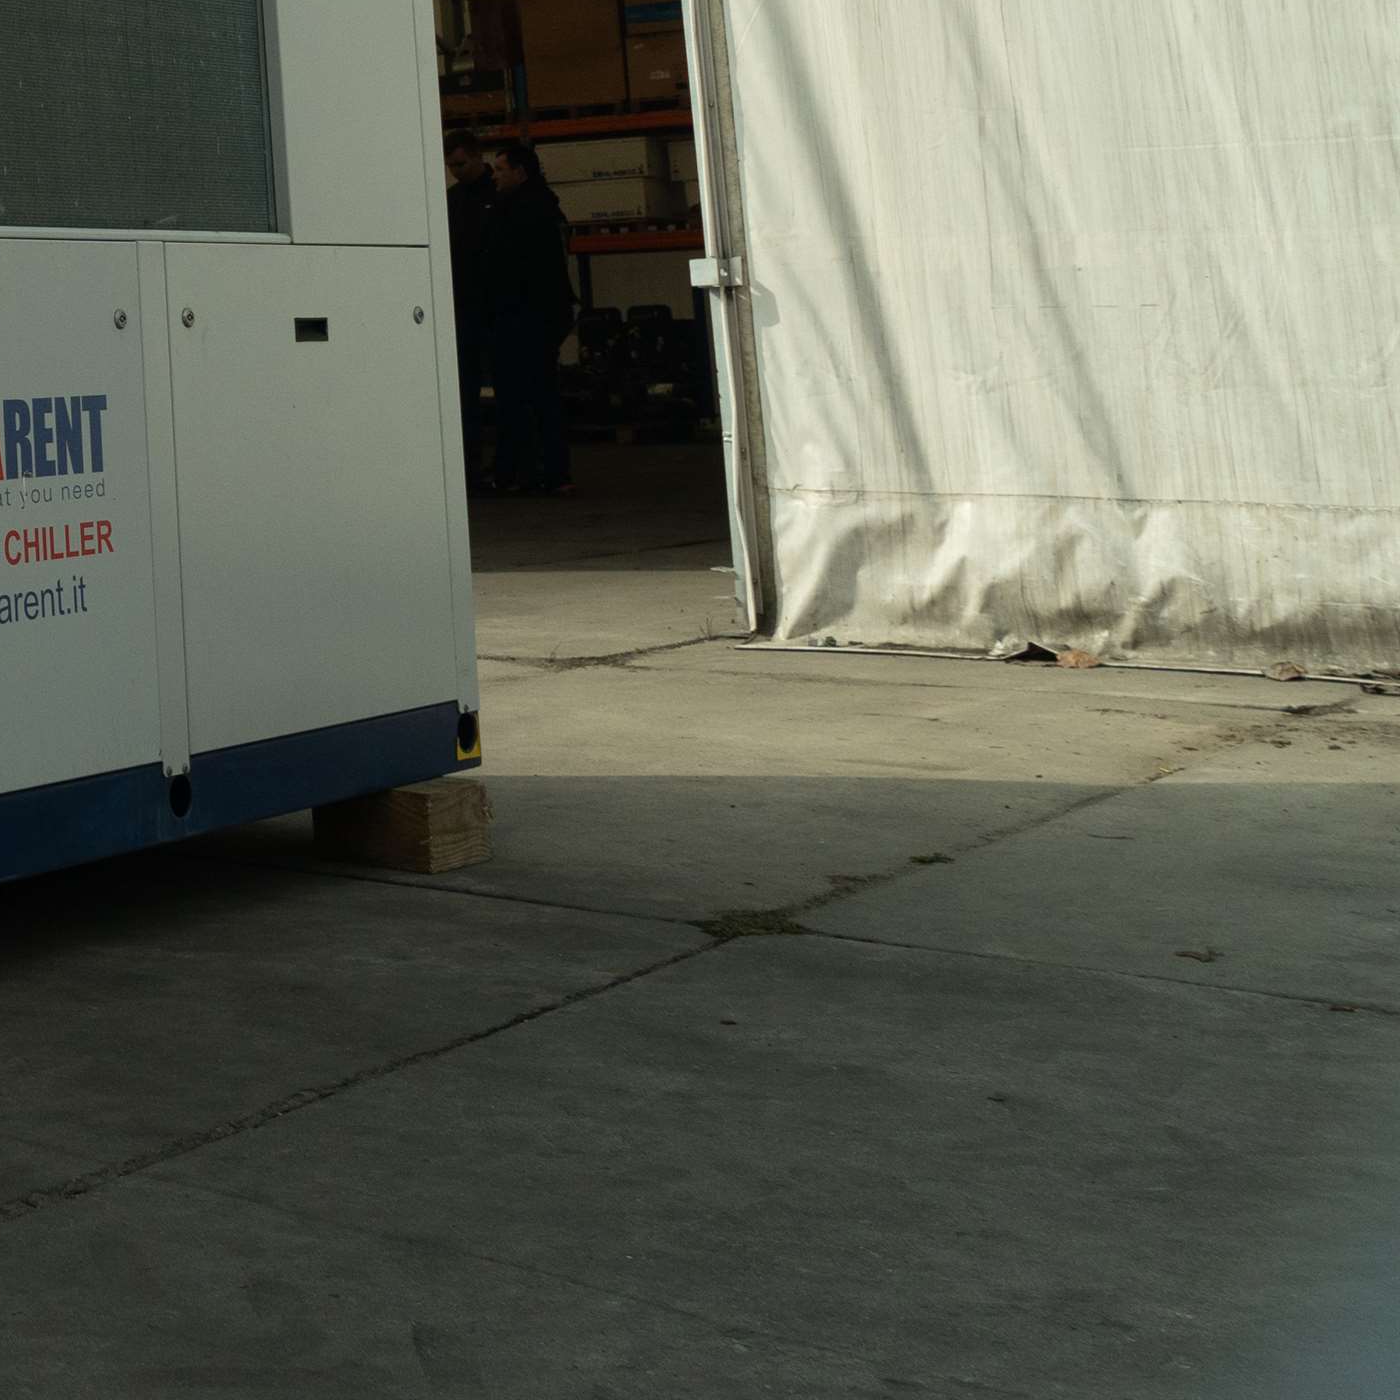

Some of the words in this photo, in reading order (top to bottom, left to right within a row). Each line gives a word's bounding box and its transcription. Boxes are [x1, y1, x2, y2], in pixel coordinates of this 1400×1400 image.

[19, 487, 53, 510] you
[61, 478, 106, 500] need
[5, 519, 115, 566] CHILLER
